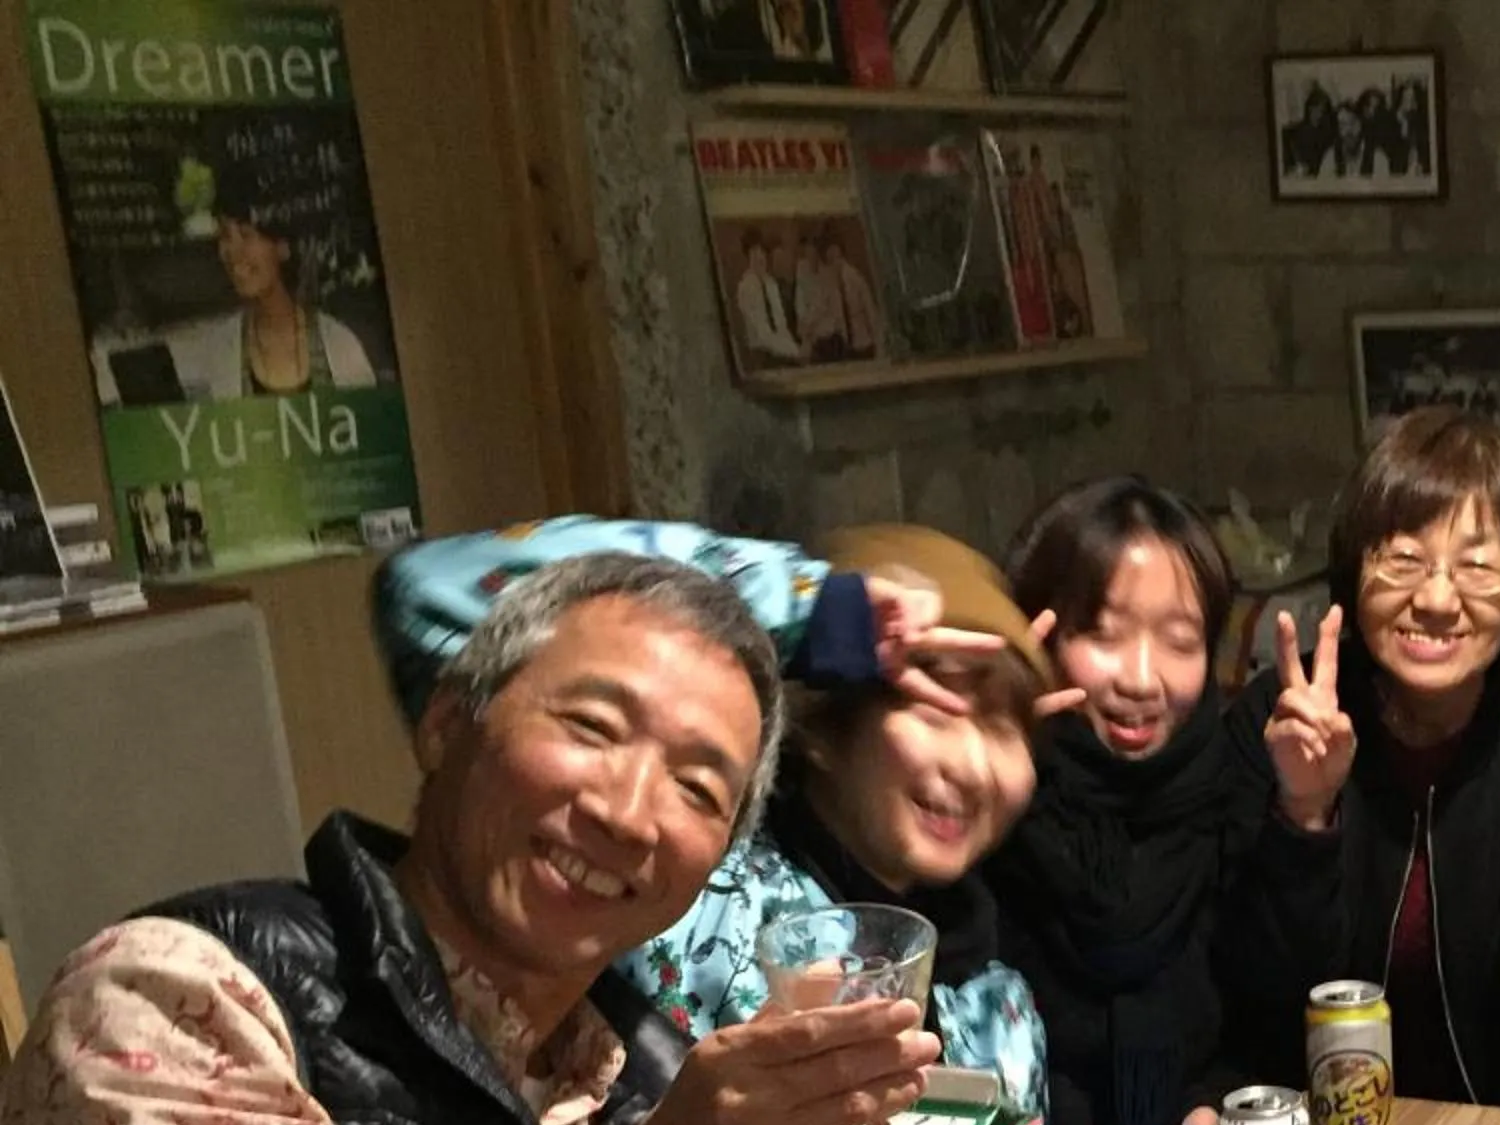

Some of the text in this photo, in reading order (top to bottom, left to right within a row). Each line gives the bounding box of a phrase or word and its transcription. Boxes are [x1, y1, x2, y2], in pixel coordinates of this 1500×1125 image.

[37, 17, 342, 98] Dreamer
[697, 138, 817, 173] BEATLES
[160, 393, 360, 471] Yu-Na
